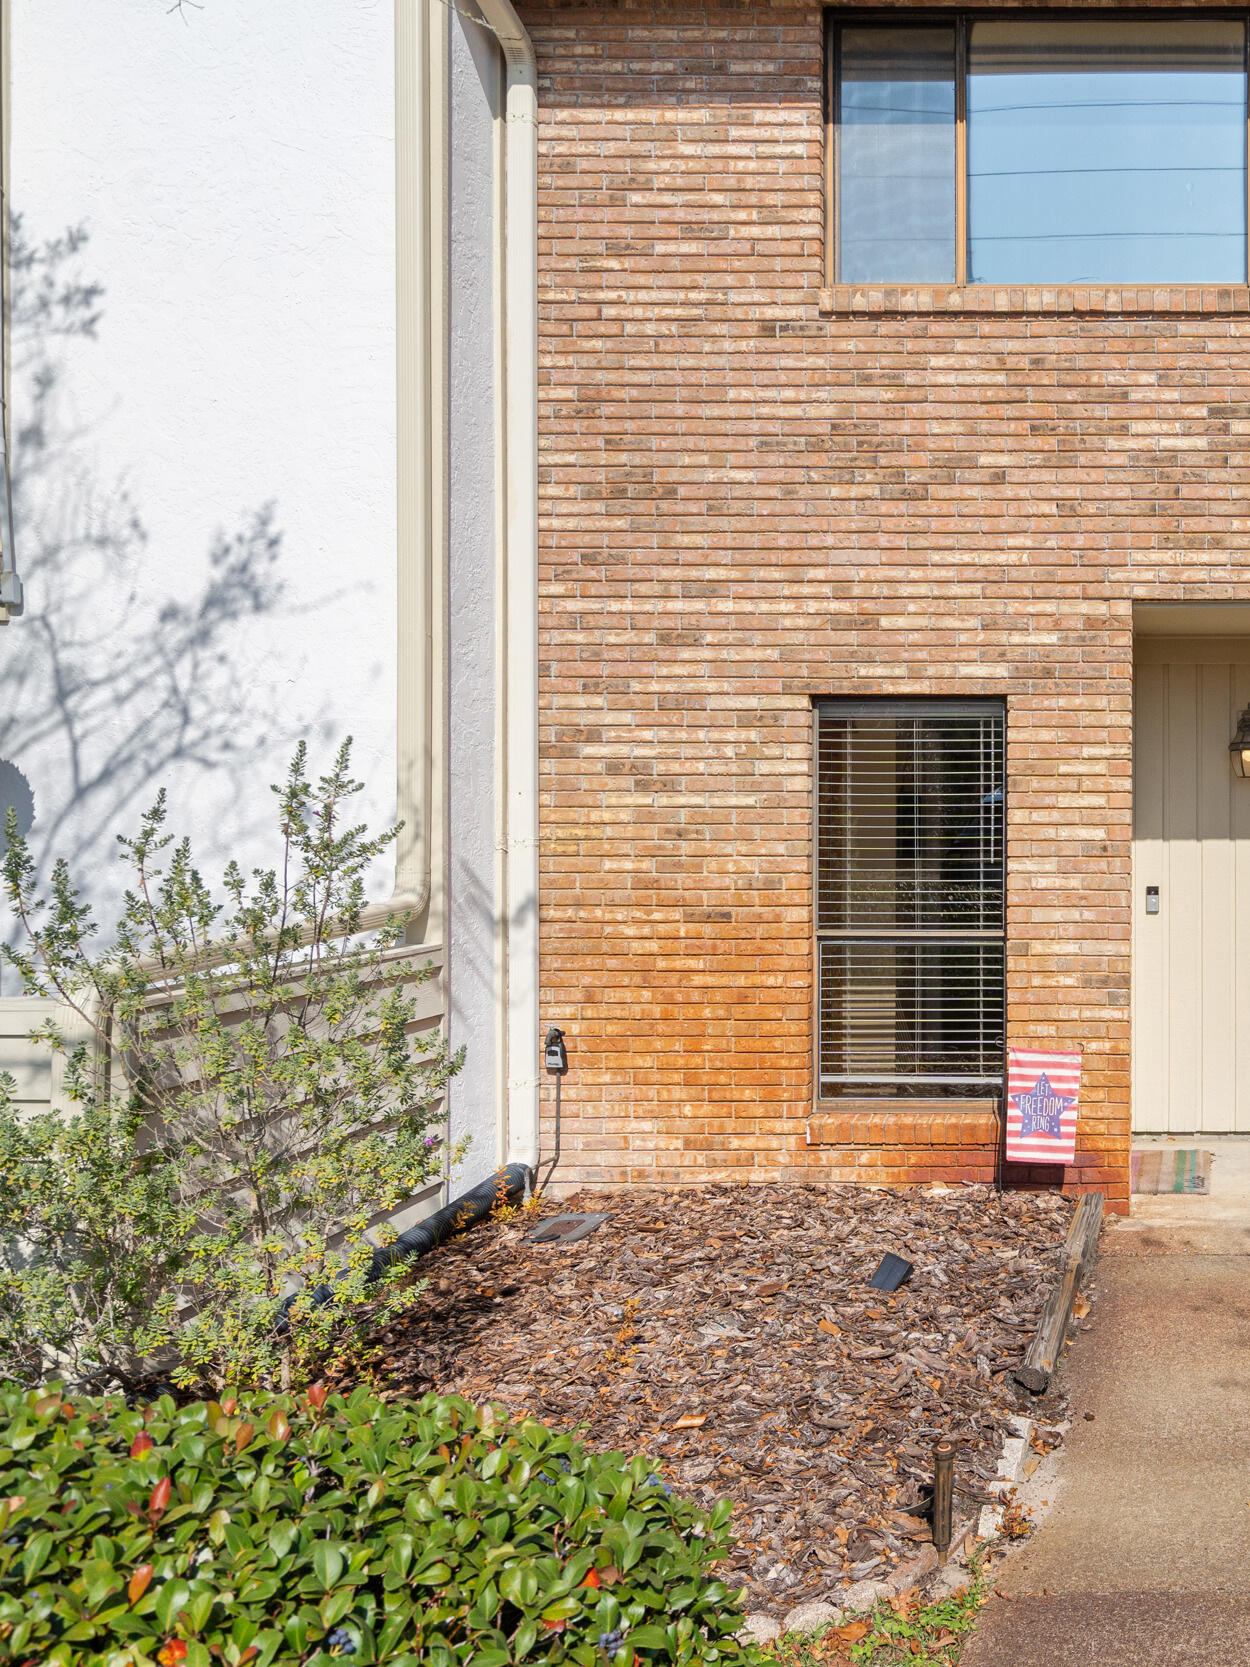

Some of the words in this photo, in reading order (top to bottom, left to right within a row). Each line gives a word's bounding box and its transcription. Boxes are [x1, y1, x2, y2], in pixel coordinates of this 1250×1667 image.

[1036, 1081, 1049, 1096] LET
[1020, 1094, 1063, 1116] FREEDOM
[1032, 1116, 1050, 1132] RING
